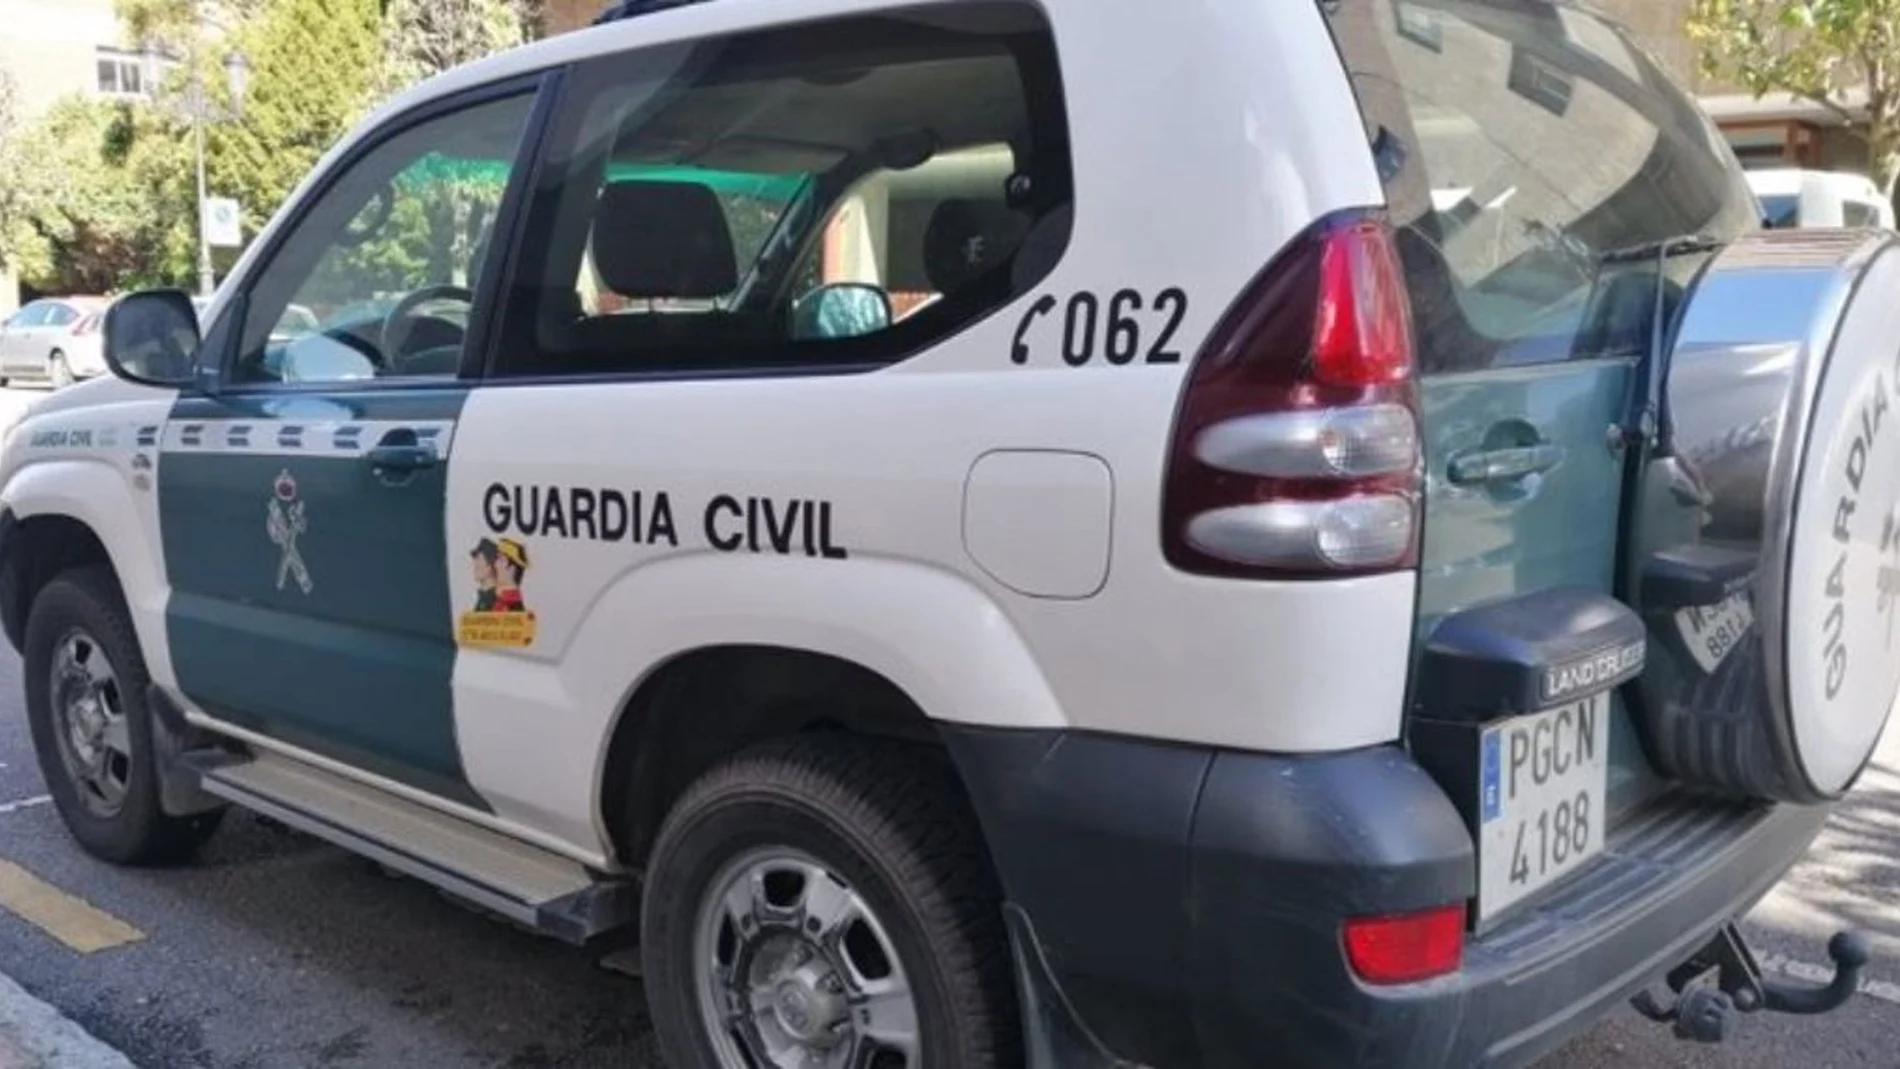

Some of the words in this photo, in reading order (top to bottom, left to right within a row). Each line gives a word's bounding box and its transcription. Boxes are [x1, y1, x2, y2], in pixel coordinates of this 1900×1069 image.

[1062, 287, 1188, 367] 062
[483, 482, 678, 546] GUARDIA
[704, 494, 848, 559] CIVIL
[1824, 372, 1888, 700] GUARDIA
[1548, 660, 1595, 696] LAND
[1510, 699, 1597, 798] PGCN
[1509, 790, 1591, 885] 4188
